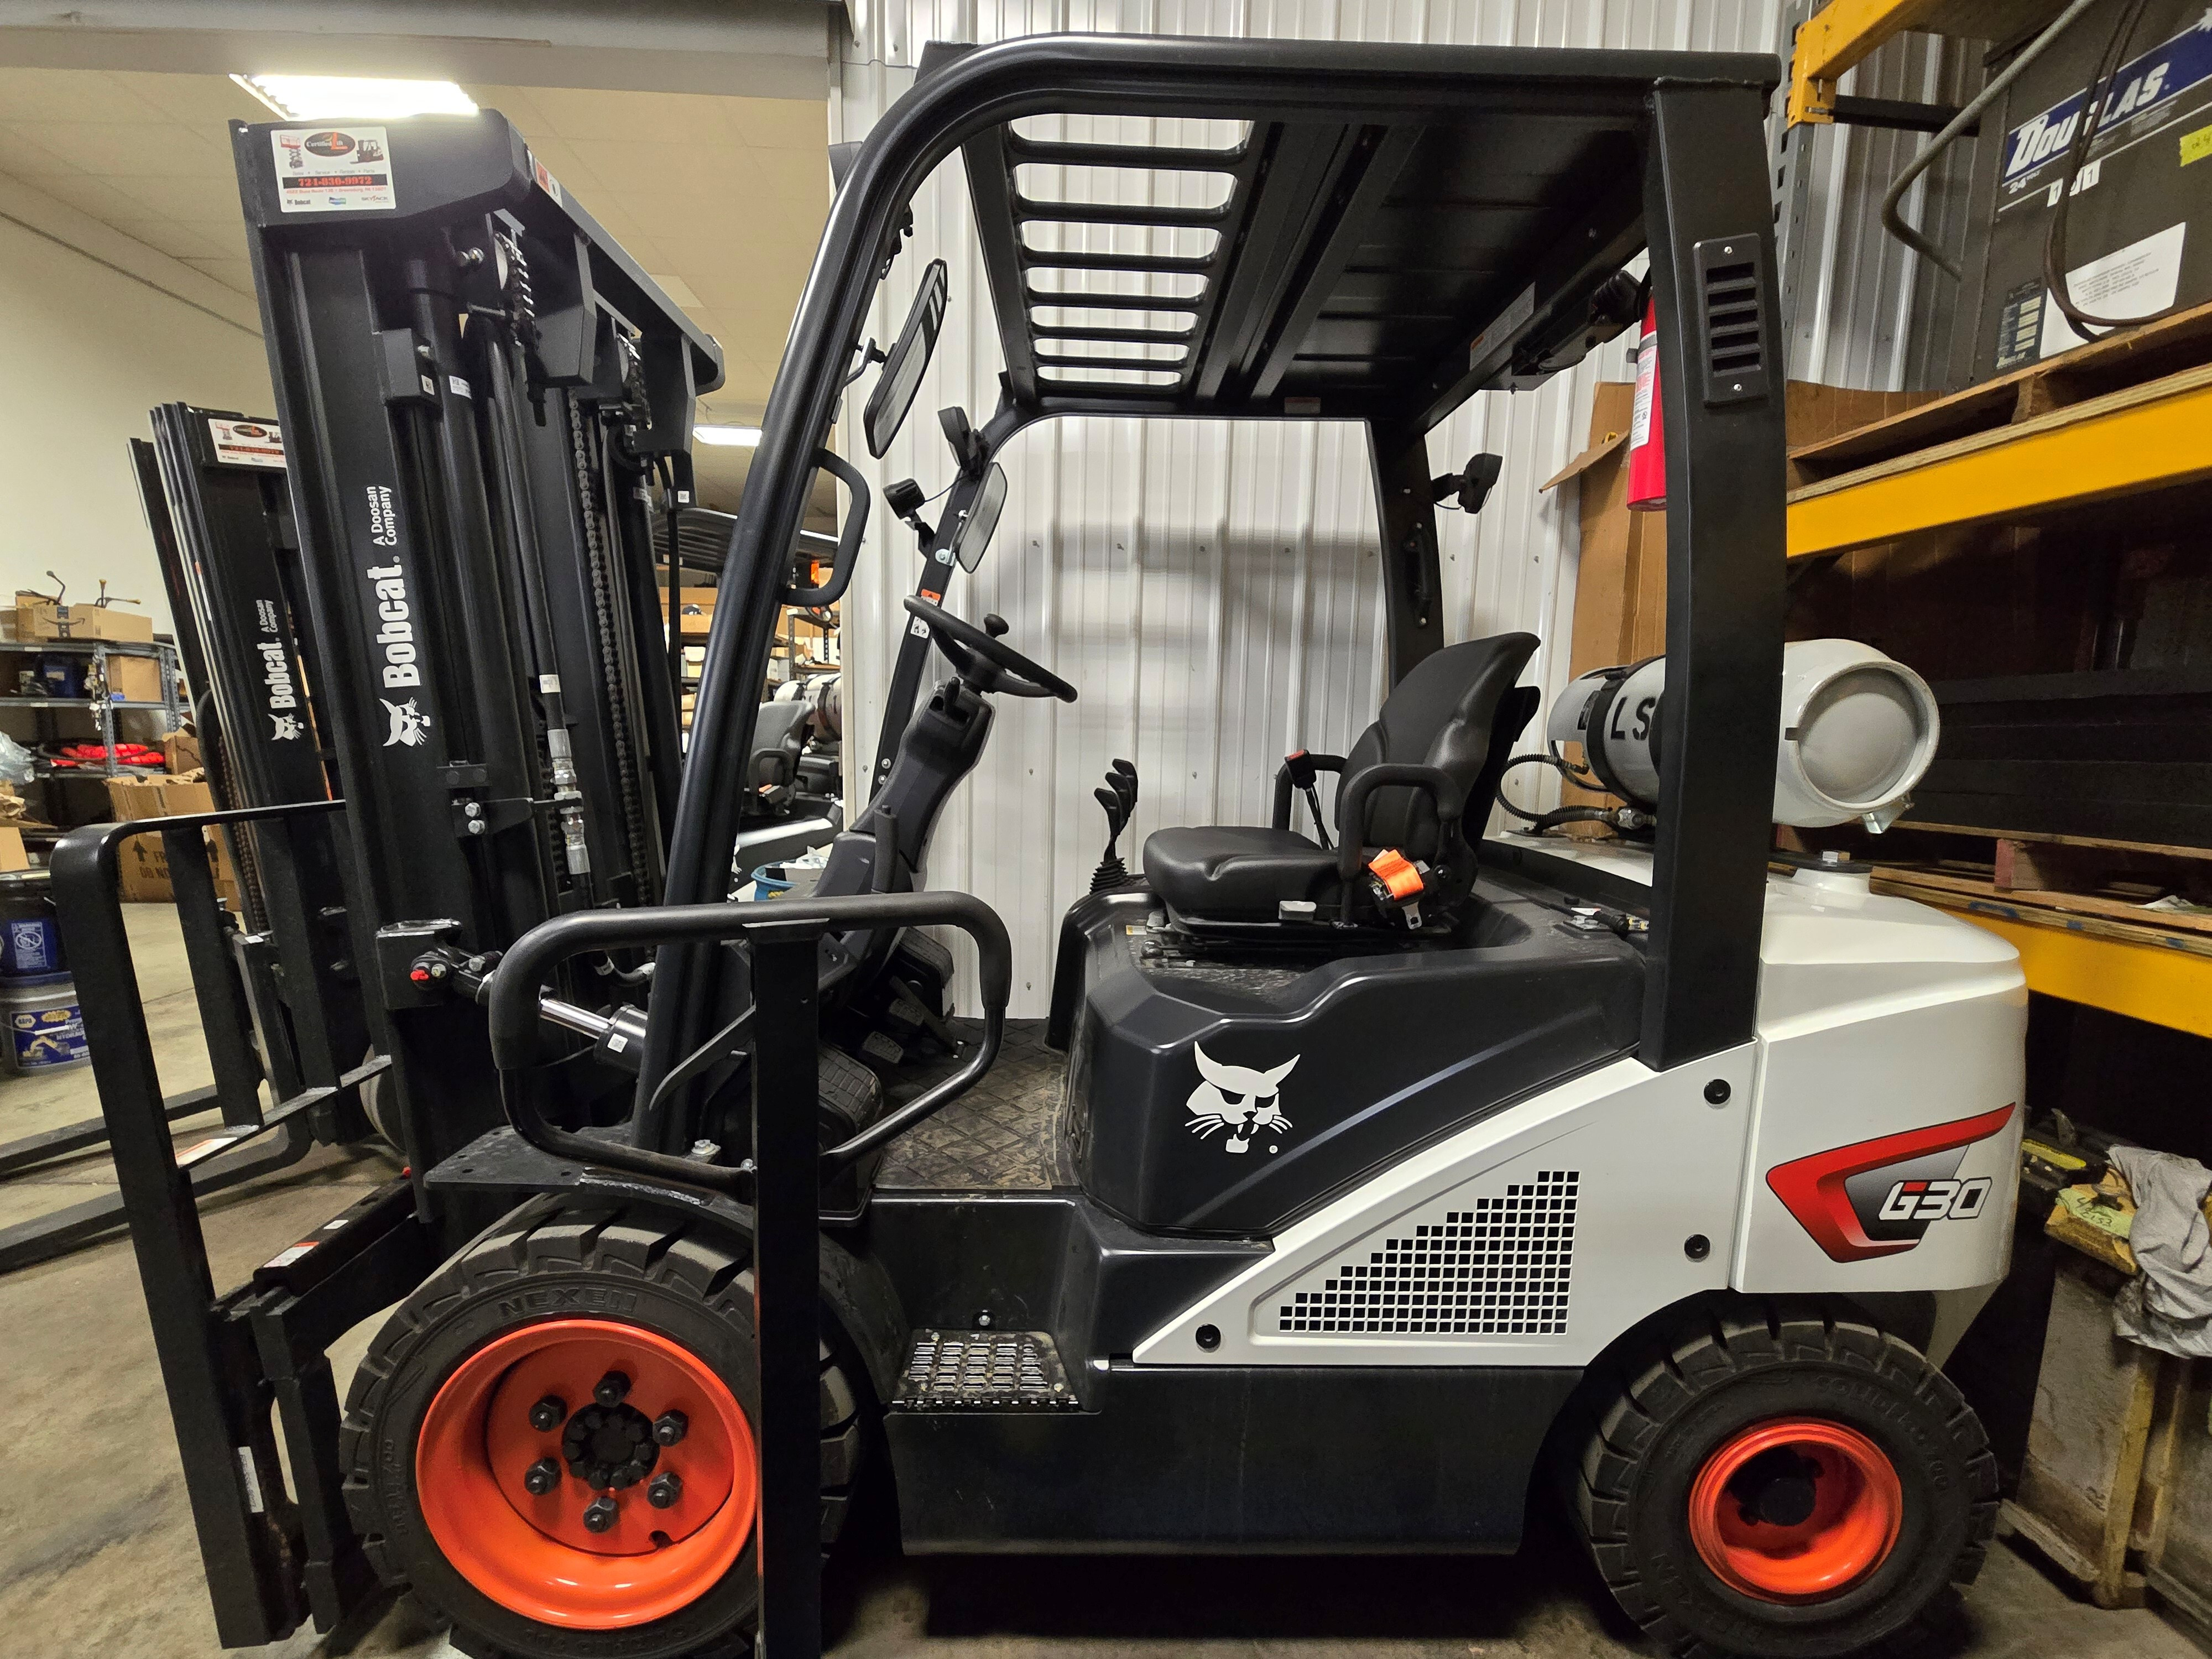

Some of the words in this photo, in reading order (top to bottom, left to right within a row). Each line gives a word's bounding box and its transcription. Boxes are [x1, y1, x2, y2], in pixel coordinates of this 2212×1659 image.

[366, 486, 383, 533] Doosan
[379, 486, 397, 546] Company
[372, 536, 386, 546] A
[256, 599, 268, 625] Doosan
[264, 599, 278, 633] Company
[367, 564, 421, 688] Bobcat
[257, 641, 297, 709] Bobcat
[1878, 1176, 1992, 1220] G30
[497, 1287, 638, 1318] NEXEN
